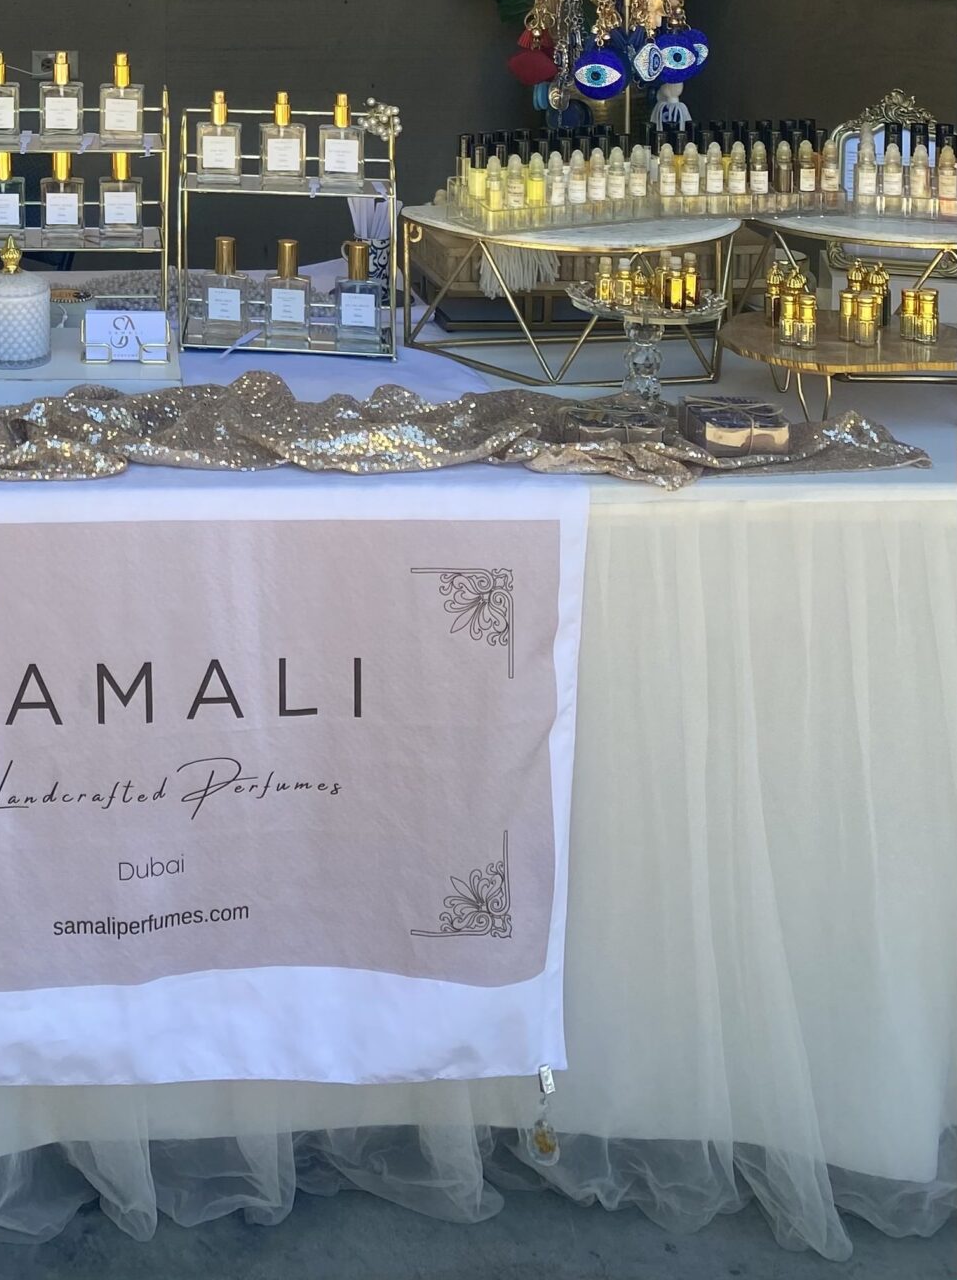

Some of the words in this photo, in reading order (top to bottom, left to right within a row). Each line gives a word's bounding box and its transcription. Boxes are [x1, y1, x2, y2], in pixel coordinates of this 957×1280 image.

[176, 756, 343, 821] Perfumes
[117, 853, 185, 882] Dubai
[52, 902, 250, 938] samaliperfumes.com
